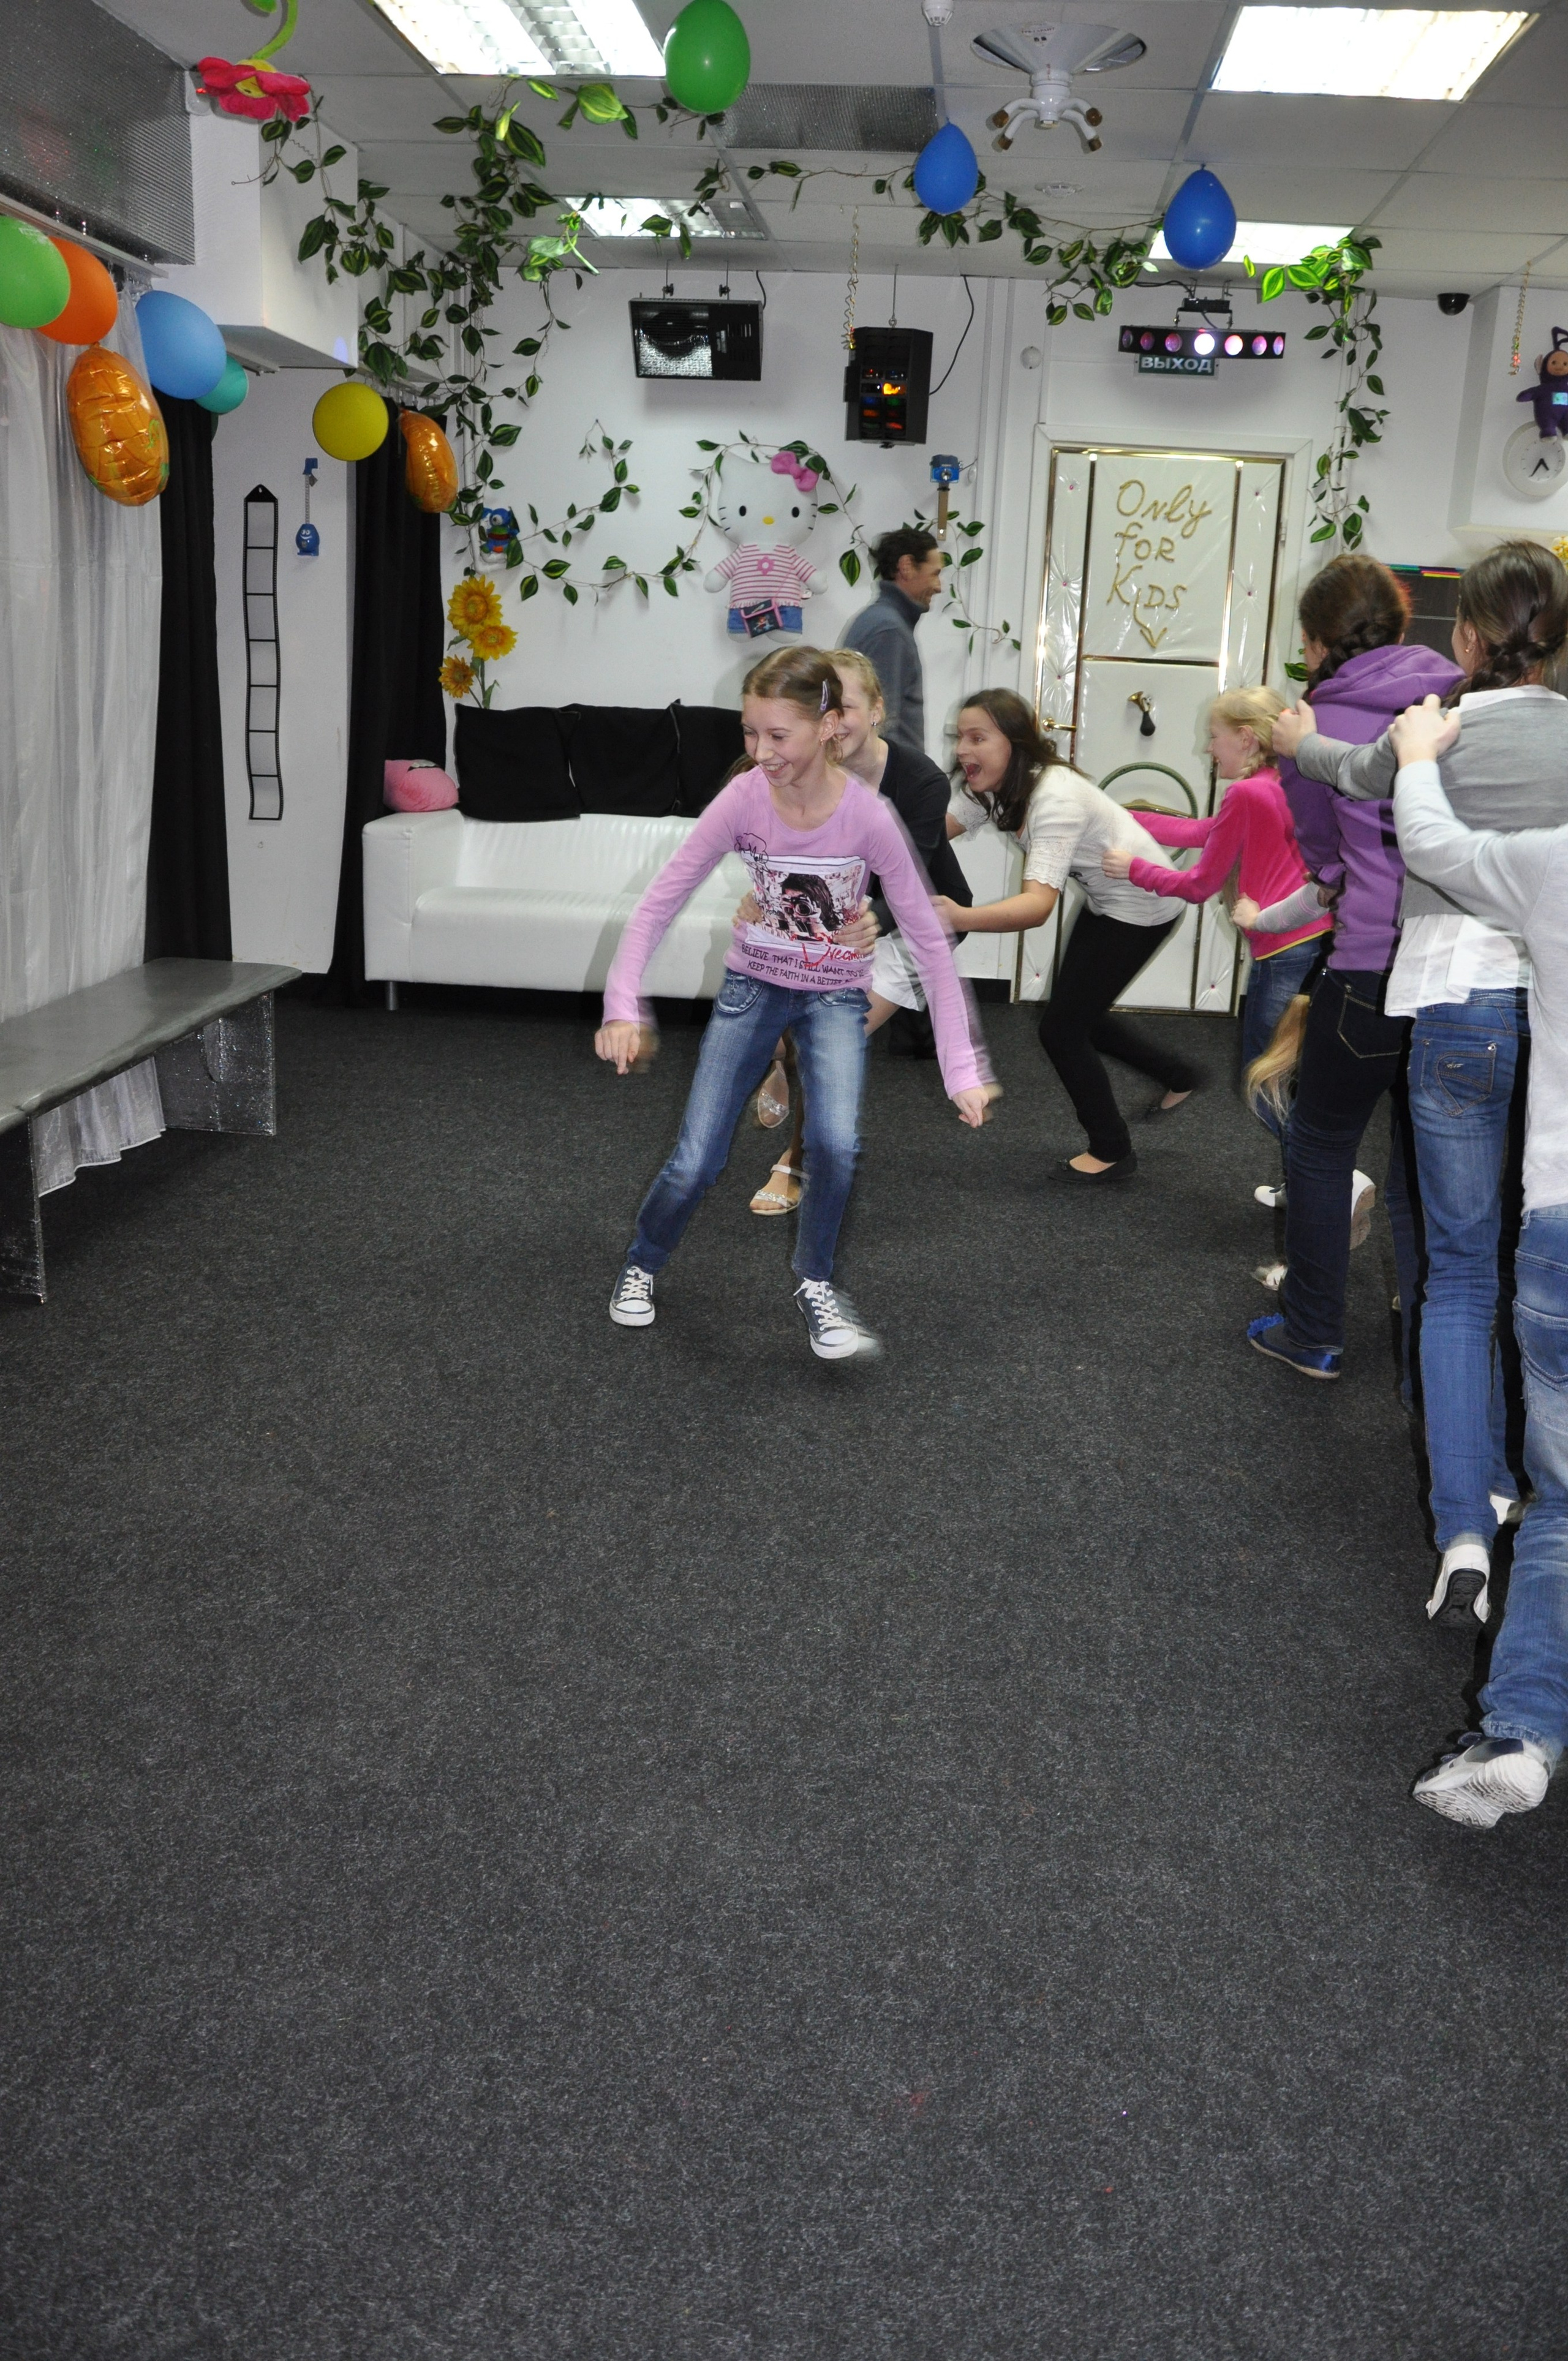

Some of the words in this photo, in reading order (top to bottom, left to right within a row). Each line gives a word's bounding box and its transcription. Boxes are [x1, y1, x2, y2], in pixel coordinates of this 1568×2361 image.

[1140, 356, 1213, 373] ВЫХОД
[742, 944, 769, 960] BELIEVE
[772, 954, 794, 966] THAT
[794, 958, 799, 968] I
[799, 960, 820, 973] STILL
[821, 964, 844, 976] WANT
[747, 960, 764, 973] KEEP
[766, 966, 779, 976] THE
[779, 969, 800, 981] FAITH
[801, 973, 809, 983] IN
[809, 976, 815, 984] A
